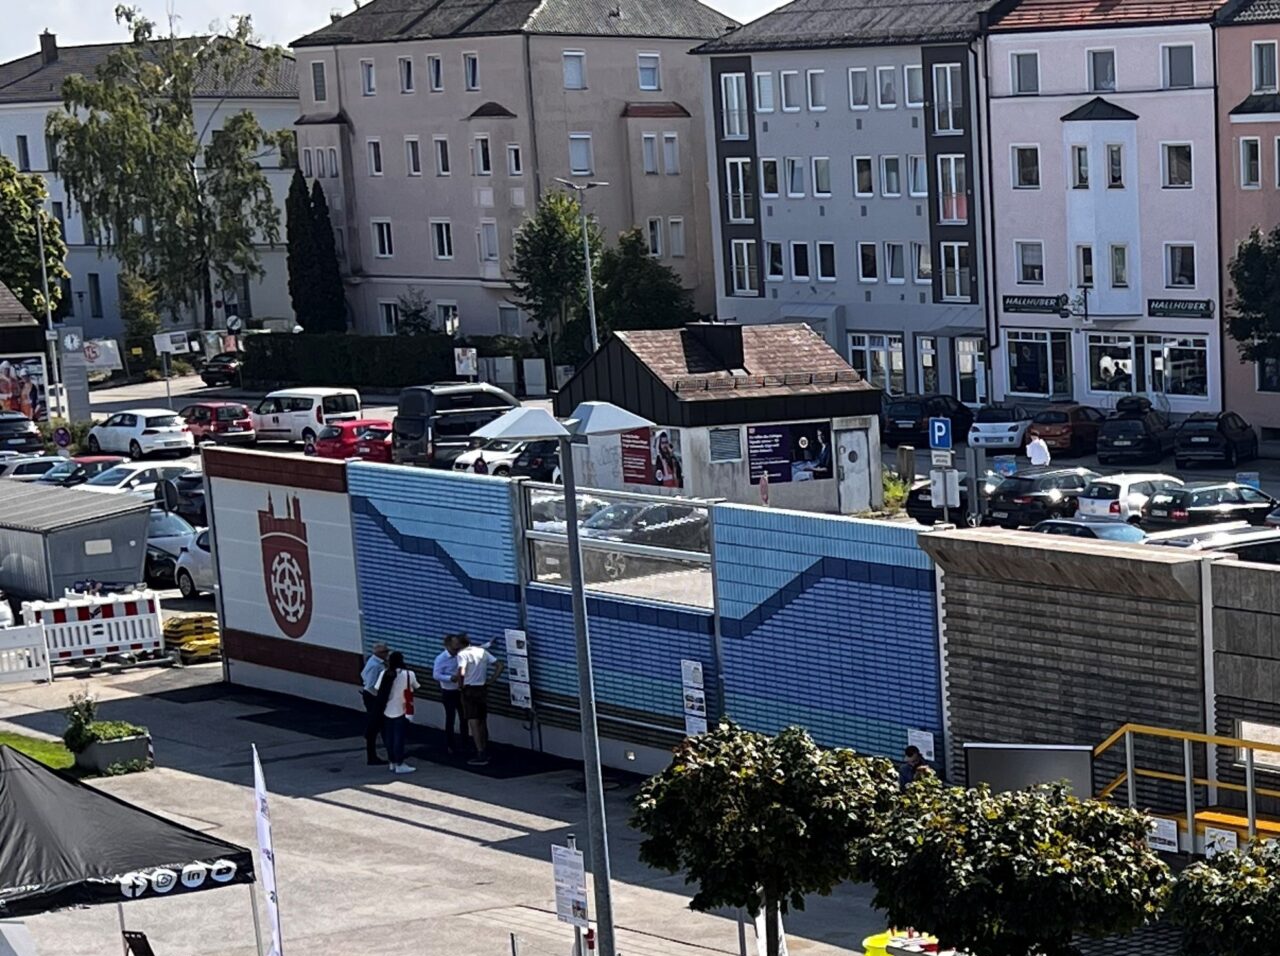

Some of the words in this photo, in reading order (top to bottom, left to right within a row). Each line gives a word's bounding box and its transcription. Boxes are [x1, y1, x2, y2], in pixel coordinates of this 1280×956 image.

[1005, 297, 1057, 307] HALLHUBER
[1151, 301, 1206, 311] HALLHUBER
[934, 421, 946, 445] P
